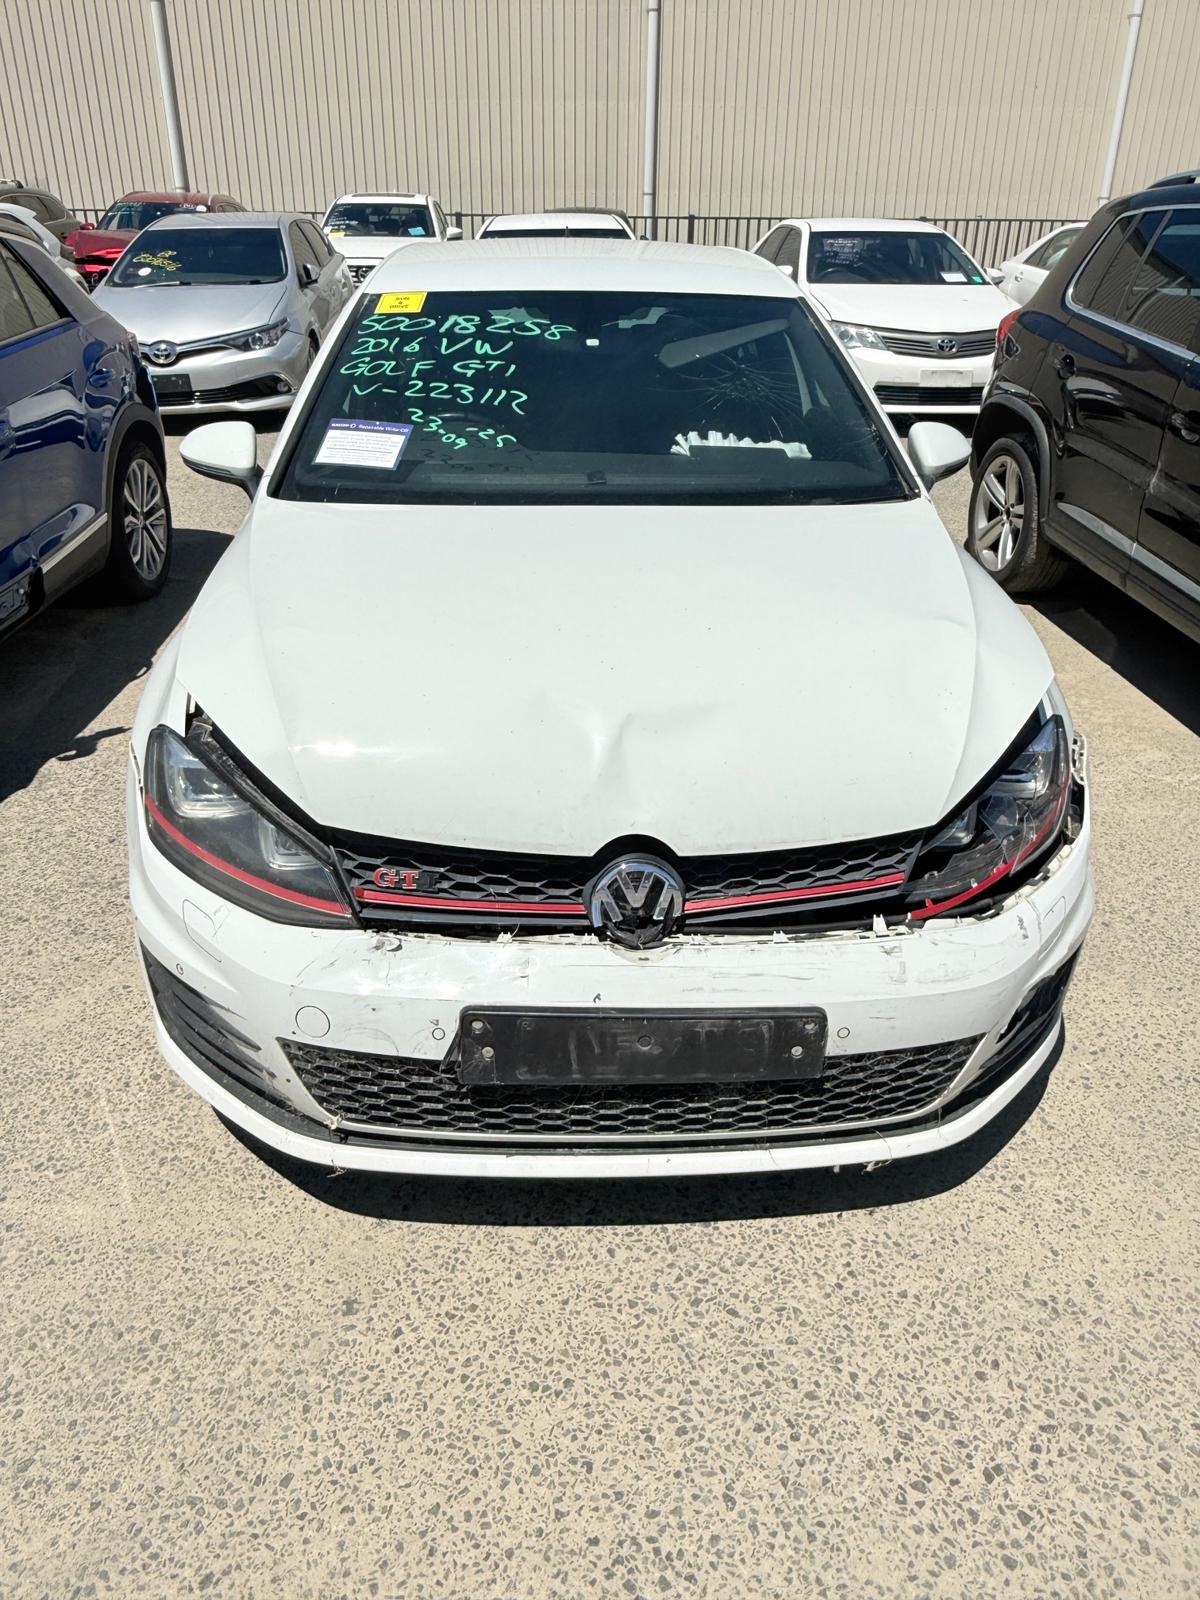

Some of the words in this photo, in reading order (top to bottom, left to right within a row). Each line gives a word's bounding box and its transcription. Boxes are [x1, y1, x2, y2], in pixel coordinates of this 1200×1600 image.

[358, 315, 576, 339] 50018258
[351, 337, 427, 355] 2016
[440, 338, 513, 355] VW
[340, 357, 436, 377] GOLF
[453, 360, 516, 377] GTI
